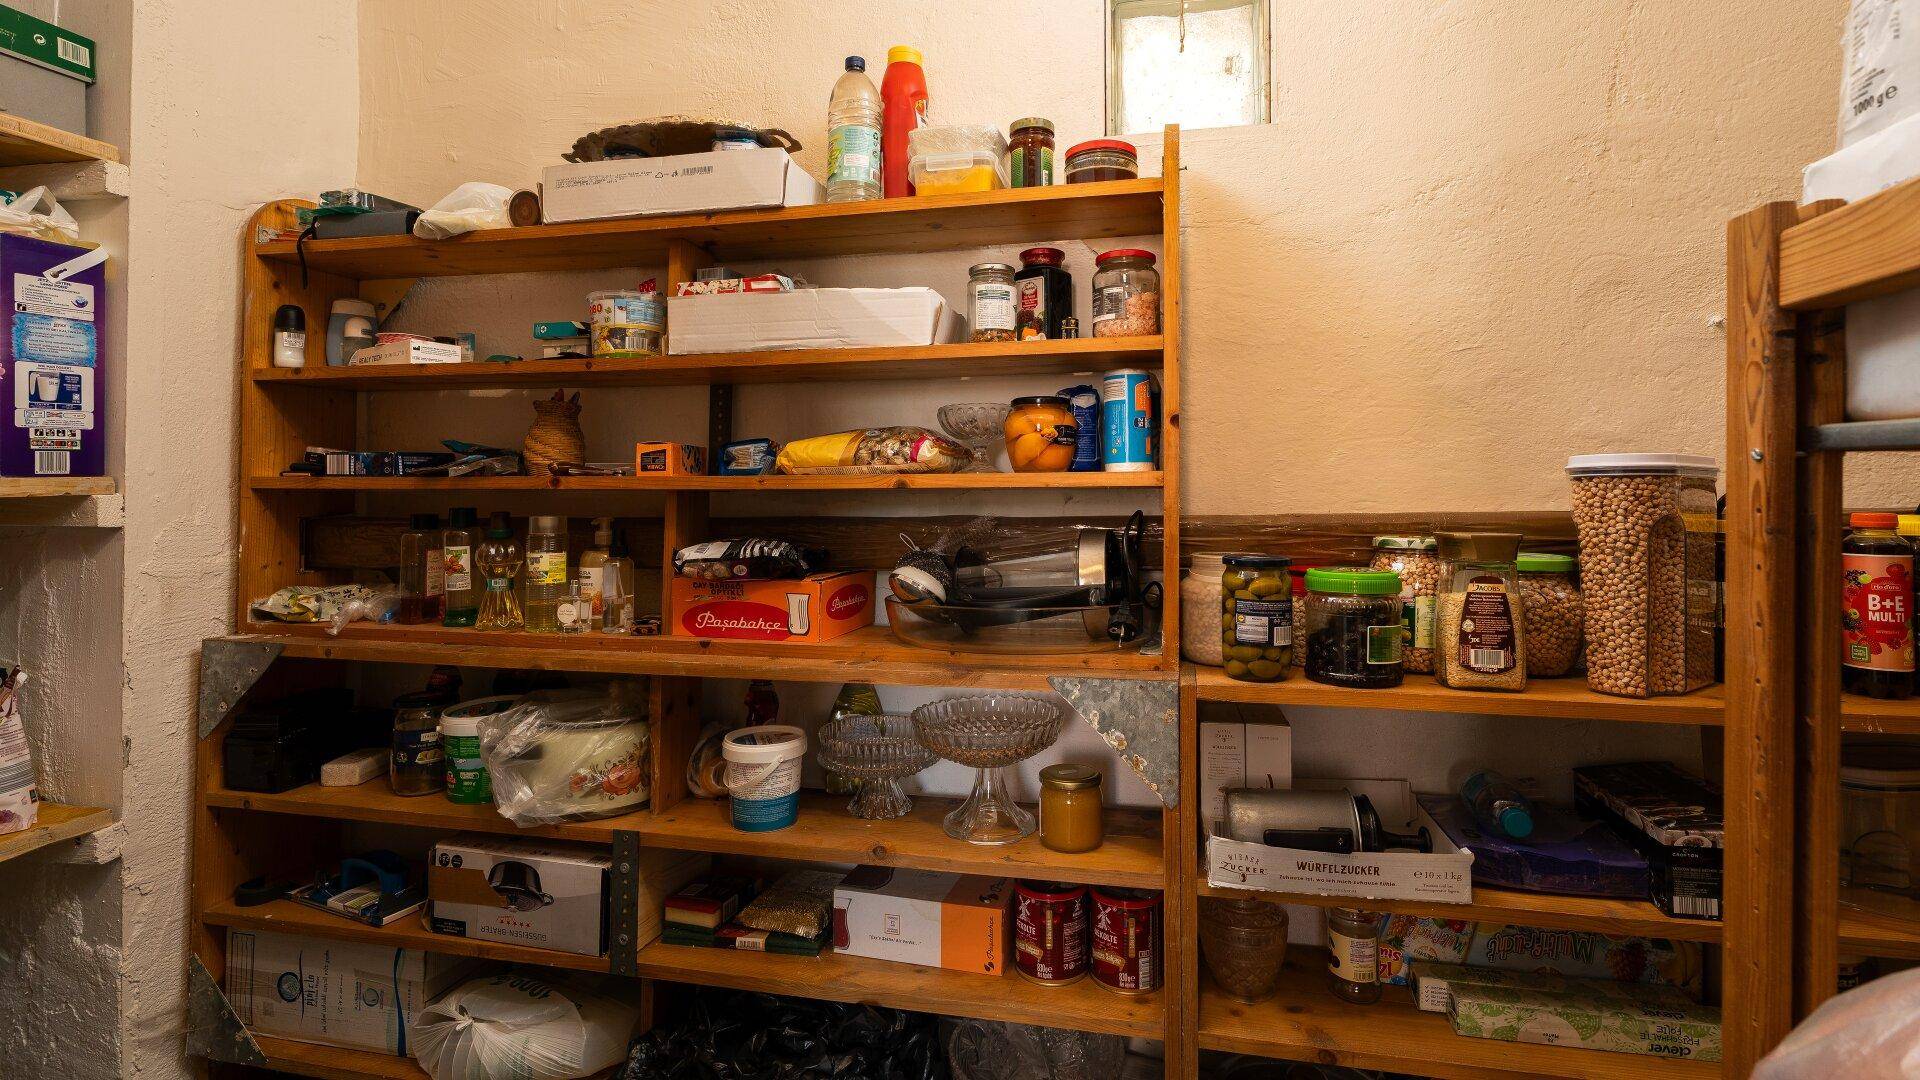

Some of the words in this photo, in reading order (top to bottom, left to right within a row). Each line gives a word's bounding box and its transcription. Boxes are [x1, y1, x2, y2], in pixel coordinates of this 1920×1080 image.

[1853, 96, 1874, 116] 1000
[1472, 584, 1501, 592] JACOBS
[1868, 594, 1905, 612] B+E
[695, 611, 788, 634] Paşabahçe
[1868, 611, 1905, 623] MULTI
[1219, 861, 1266, 875] ZUCKER
[1296, 860, 1380, 876] WÜRFELZUCKER
[1451, 872, 1463, 881] kg
[1640, 1033, 1700, 1045] FRISCHHALTE
[1650, 1043, 1692, 1057] clever
